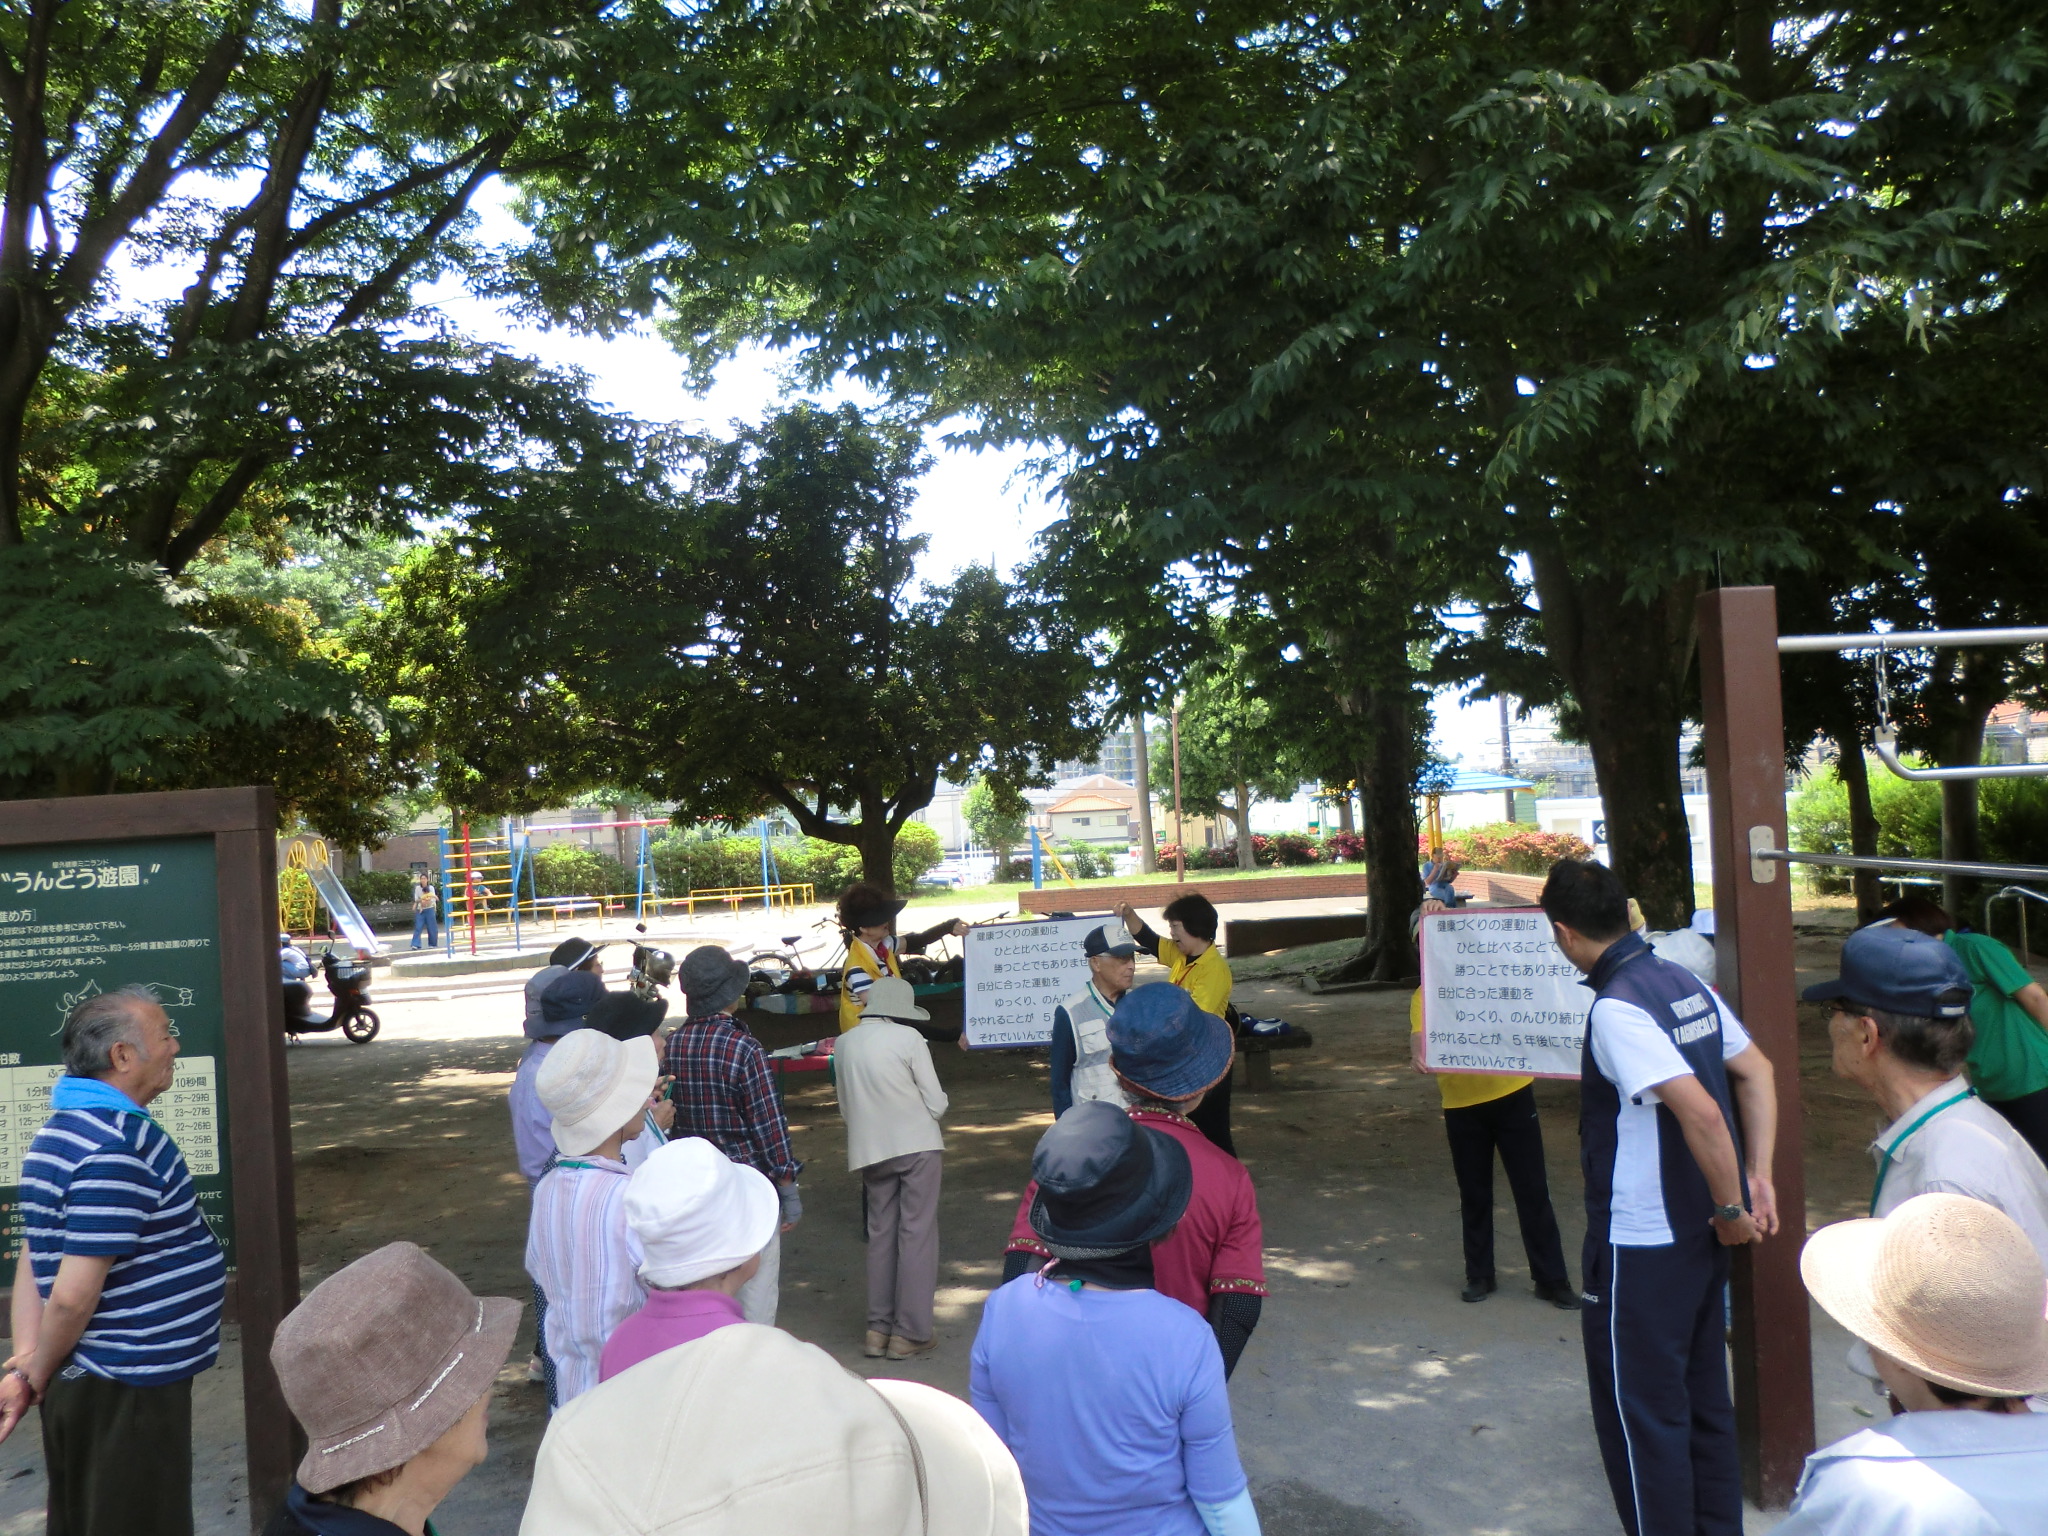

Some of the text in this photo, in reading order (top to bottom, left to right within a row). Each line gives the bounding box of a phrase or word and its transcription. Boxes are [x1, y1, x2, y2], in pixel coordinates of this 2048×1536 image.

[1437, 918, 1537, 932] 健康づくりの運動は
[977, 925, 1059, 941] 健康づくりの運動は
[977, 977, 1060, 992] 自分に合った運動を
[1438, 987, 1534, 1000] 自分に合った運動を
[969, 1013, 1034, 1027] 今やれることが
[1429, 1032, 1501, 1045] 今やれることが
[1438, 1054, 1534, 1070] それでいいんです。
[175, 1076, 207, 1088] 10秒間
